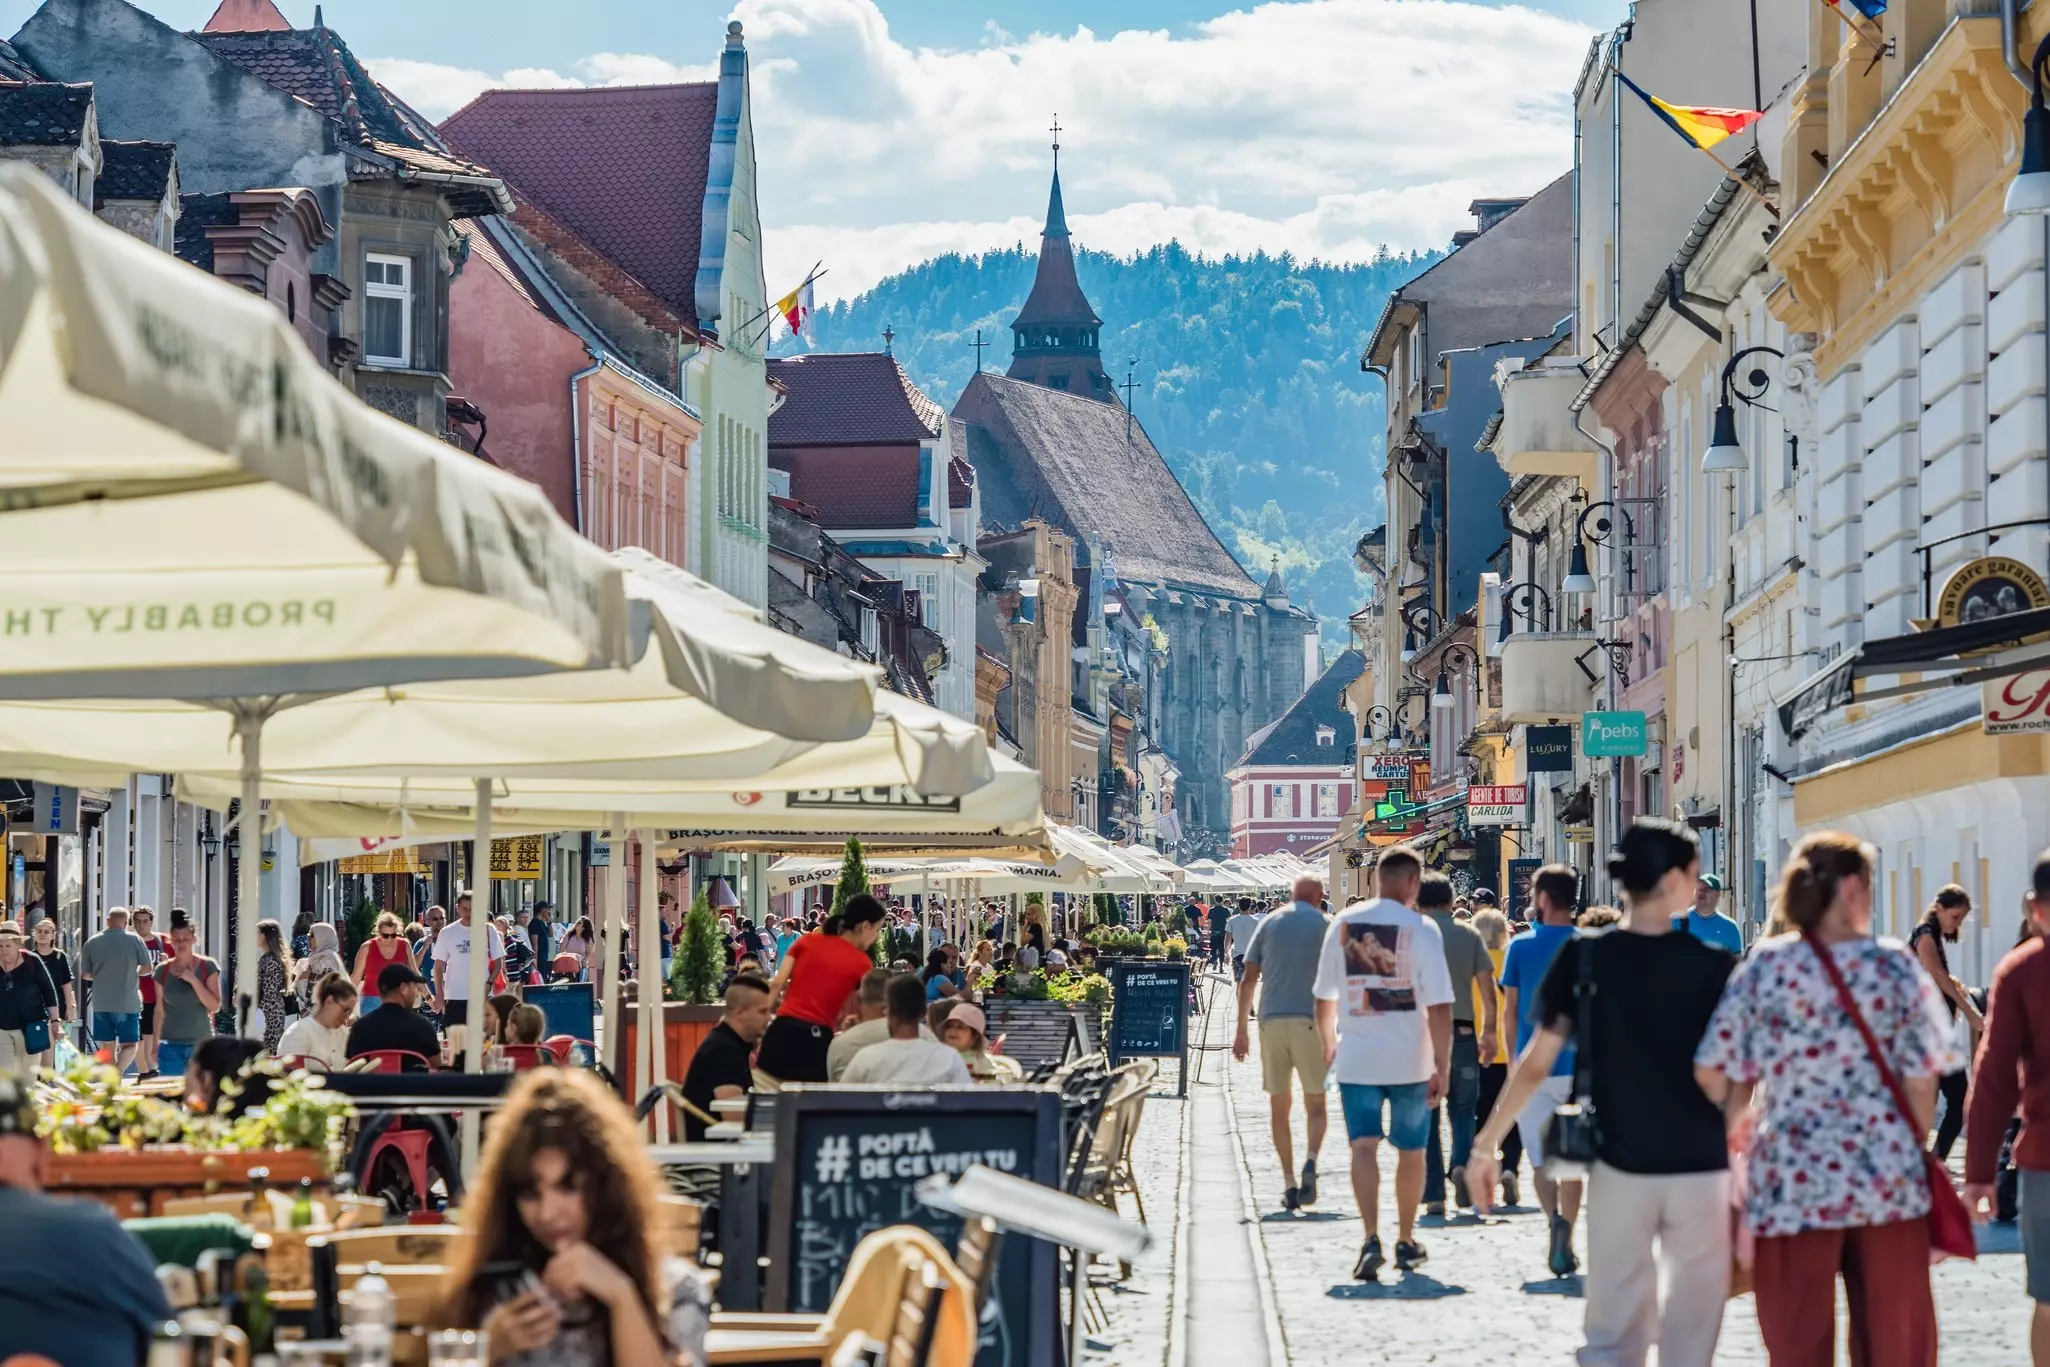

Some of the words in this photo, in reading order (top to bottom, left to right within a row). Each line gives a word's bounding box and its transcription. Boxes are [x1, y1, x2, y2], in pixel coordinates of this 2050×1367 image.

[1602, 722, 1640, 742] pebs
[1530, 743, 1568, 755] LUXURY
[1471, 806, 1513, 816] CARLIDA
[859, 1157, 892, 1179] DE
[895, 1154, 926, 1175] CE
